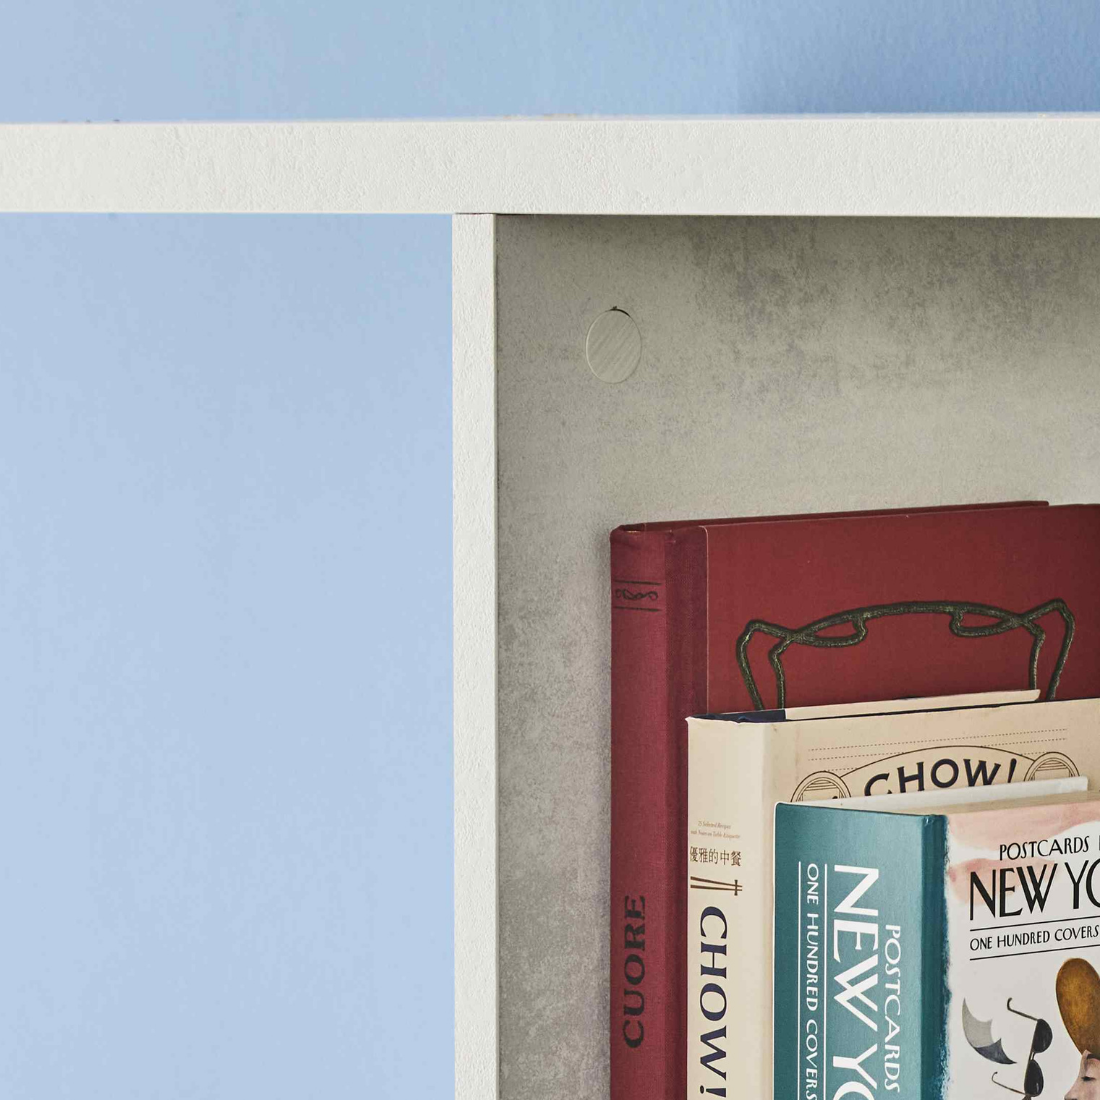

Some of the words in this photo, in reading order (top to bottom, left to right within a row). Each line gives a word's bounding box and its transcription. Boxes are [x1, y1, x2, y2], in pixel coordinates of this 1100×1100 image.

[806, 863, 819, 905] ONE
[970, 863, 1058, 920] NEW
[1000, 836, 1089, 860] POSTCARDS
[622, 895, 646, 1048] CUORE
[806, 913, 819, 1011] HUNDRED
[834, 864, 879, 1032] NEW
[970, 937, 993, 951] ONE
[997, 930, 1050, 948] HUNDRED
[1054, 925, 1099, 943] COVERS
[700, 906, 728, 1098] CHOW!
[885, 924, 901, 1092] POSTCARDS
